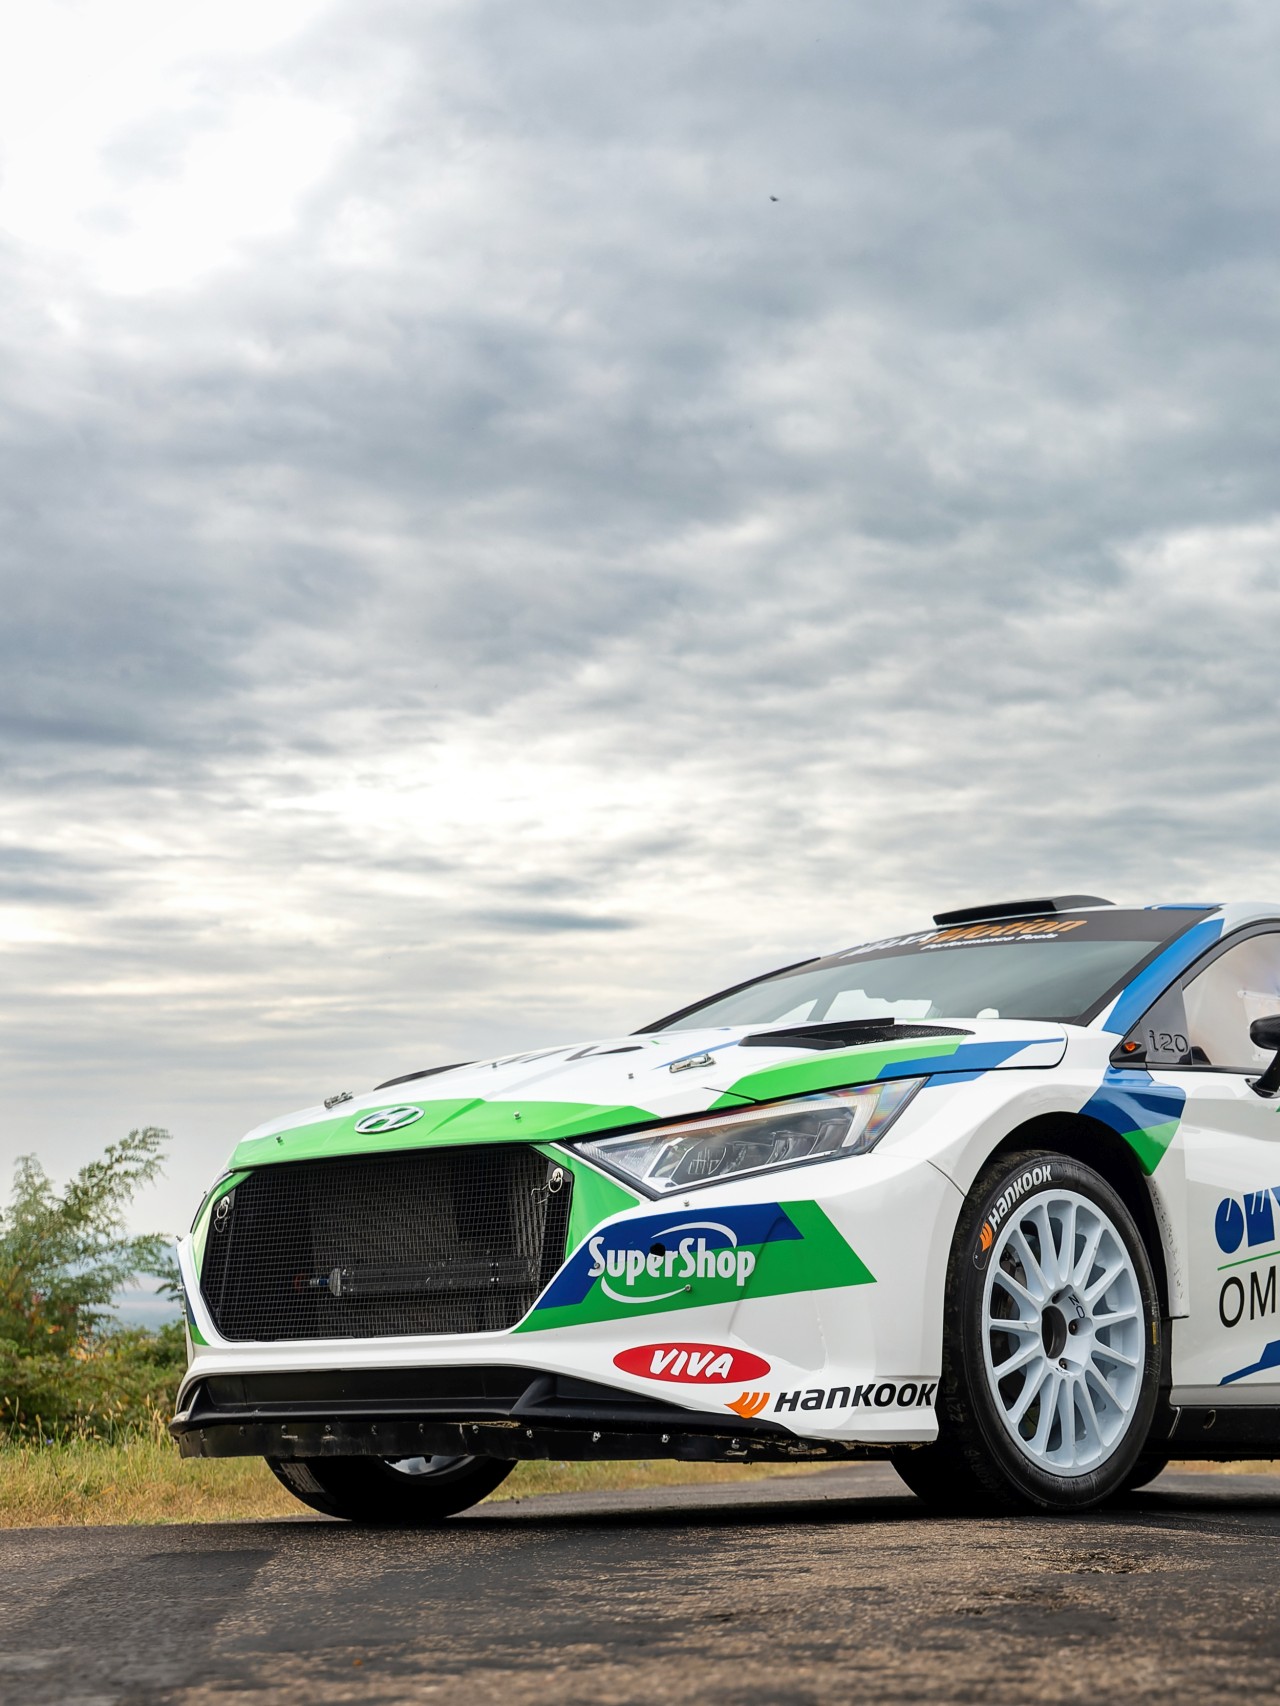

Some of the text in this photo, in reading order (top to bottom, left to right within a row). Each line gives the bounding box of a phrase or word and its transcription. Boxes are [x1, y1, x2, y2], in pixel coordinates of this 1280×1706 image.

[1149, 1030, 1188, 1053] i20
[587, 1236, 755, 1286] SuperShop
[649, 1349, 735, 1379] VIVA
